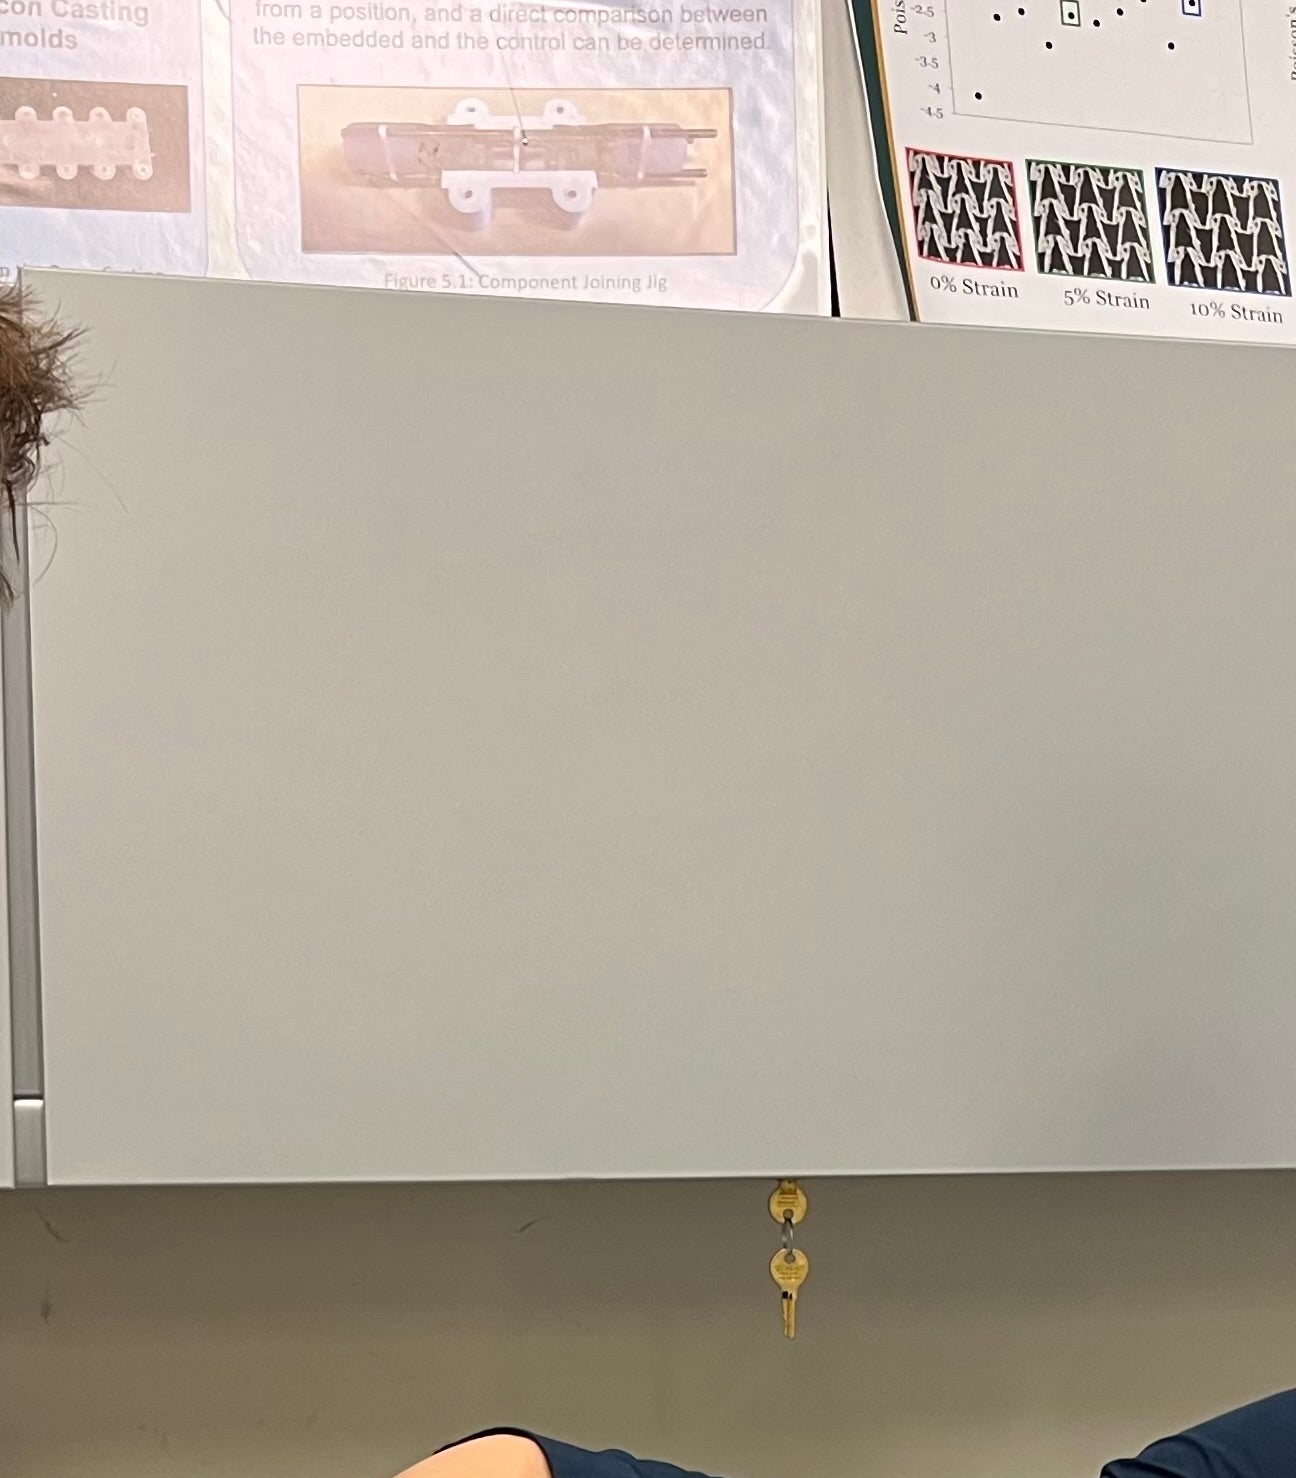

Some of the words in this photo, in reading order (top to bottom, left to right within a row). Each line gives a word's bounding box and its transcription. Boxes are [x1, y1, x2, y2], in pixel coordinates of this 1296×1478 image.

[52, 0, 150, 27] Casting
[330, 4, 417, 25] position,
[424, 5, 463, 23] and
[470, 8, 482, 23] a
[489, 5, 547, 23] direct
[553, 7, 673, 26] comparison
[680, 6, 768, 24] between
[1, 28, 78, 51] molds
[253, 27, 286, 46] the
[292, 30, 404, 49] embedded
[411, 31, 450, 49] and
[456, 32, 489, 50] the
[496, 33, 566, 51] control
[573, 37, 609, 51] can
[617, 34, 642, 51] be
[384, 273, 437, 291] Figure
[478, 274, 577, 293] Component
[583, 274, 641, 293] Joining
[646, 274, 668, 292] Jig
[930, 275, 958, 294] 0%
[963, 278, 1020, 299] Strain
[1063, 288, 1091, 306] 5%
[1095, 290, 1151, 311] Strain
[1190, 301, 1226, 319] 10%
[1230, 303, 1284, 325] Strain
